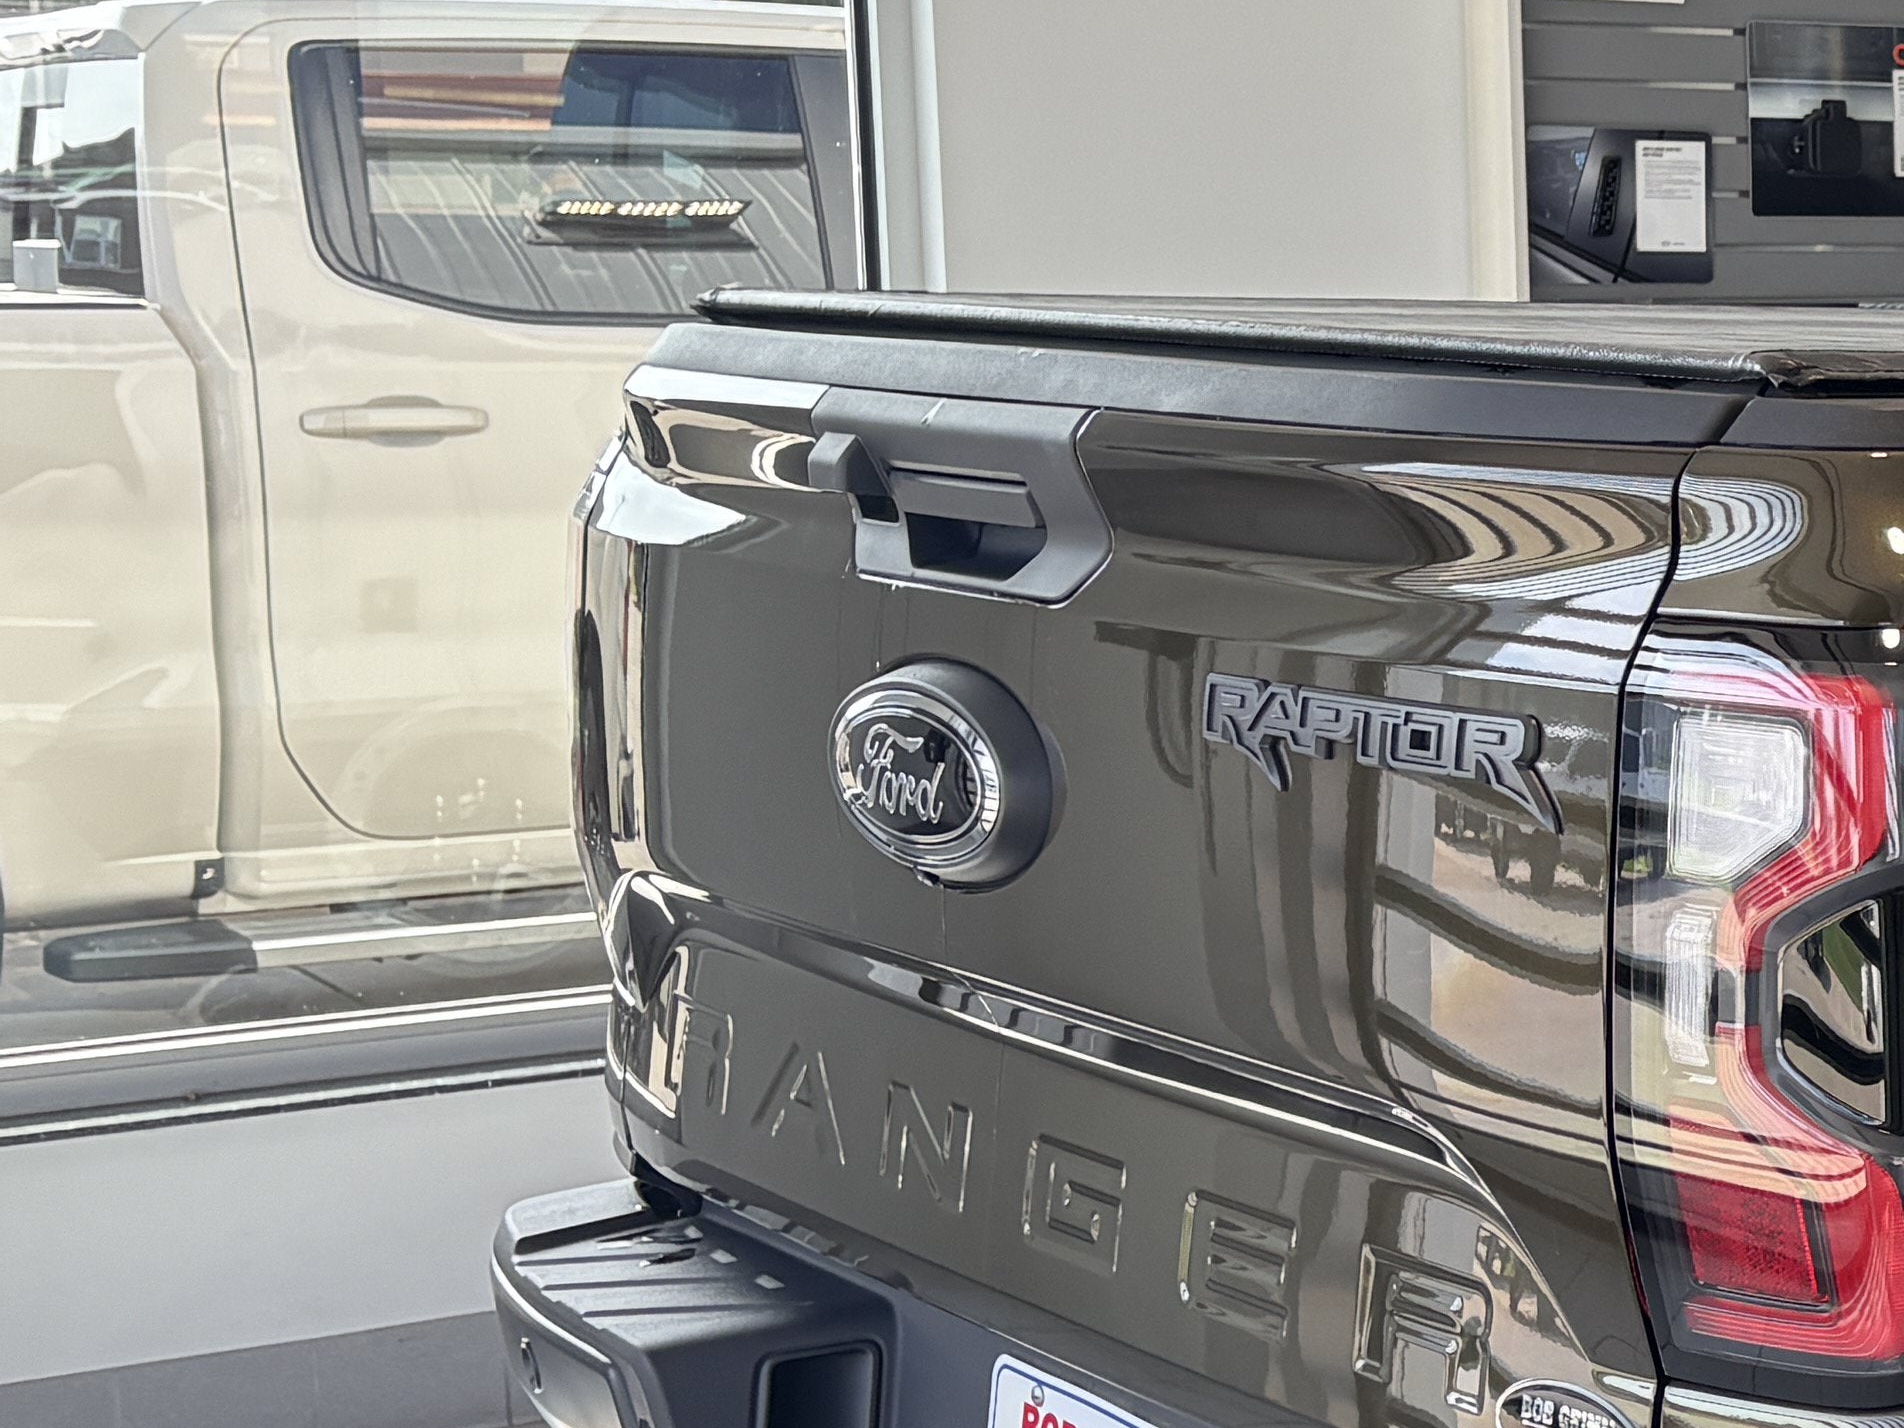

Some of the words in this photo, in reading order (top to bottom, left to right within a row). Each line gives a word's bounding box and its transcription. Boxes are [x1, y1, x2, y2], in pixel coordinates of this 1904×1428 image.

[845, 723, 945, 824] Ford
[1203, 672, 1563, 835] RAPTOR
[670, 988, 1494, 1415] RANGER
[1521, 1393, 1554, 1426] BOB
